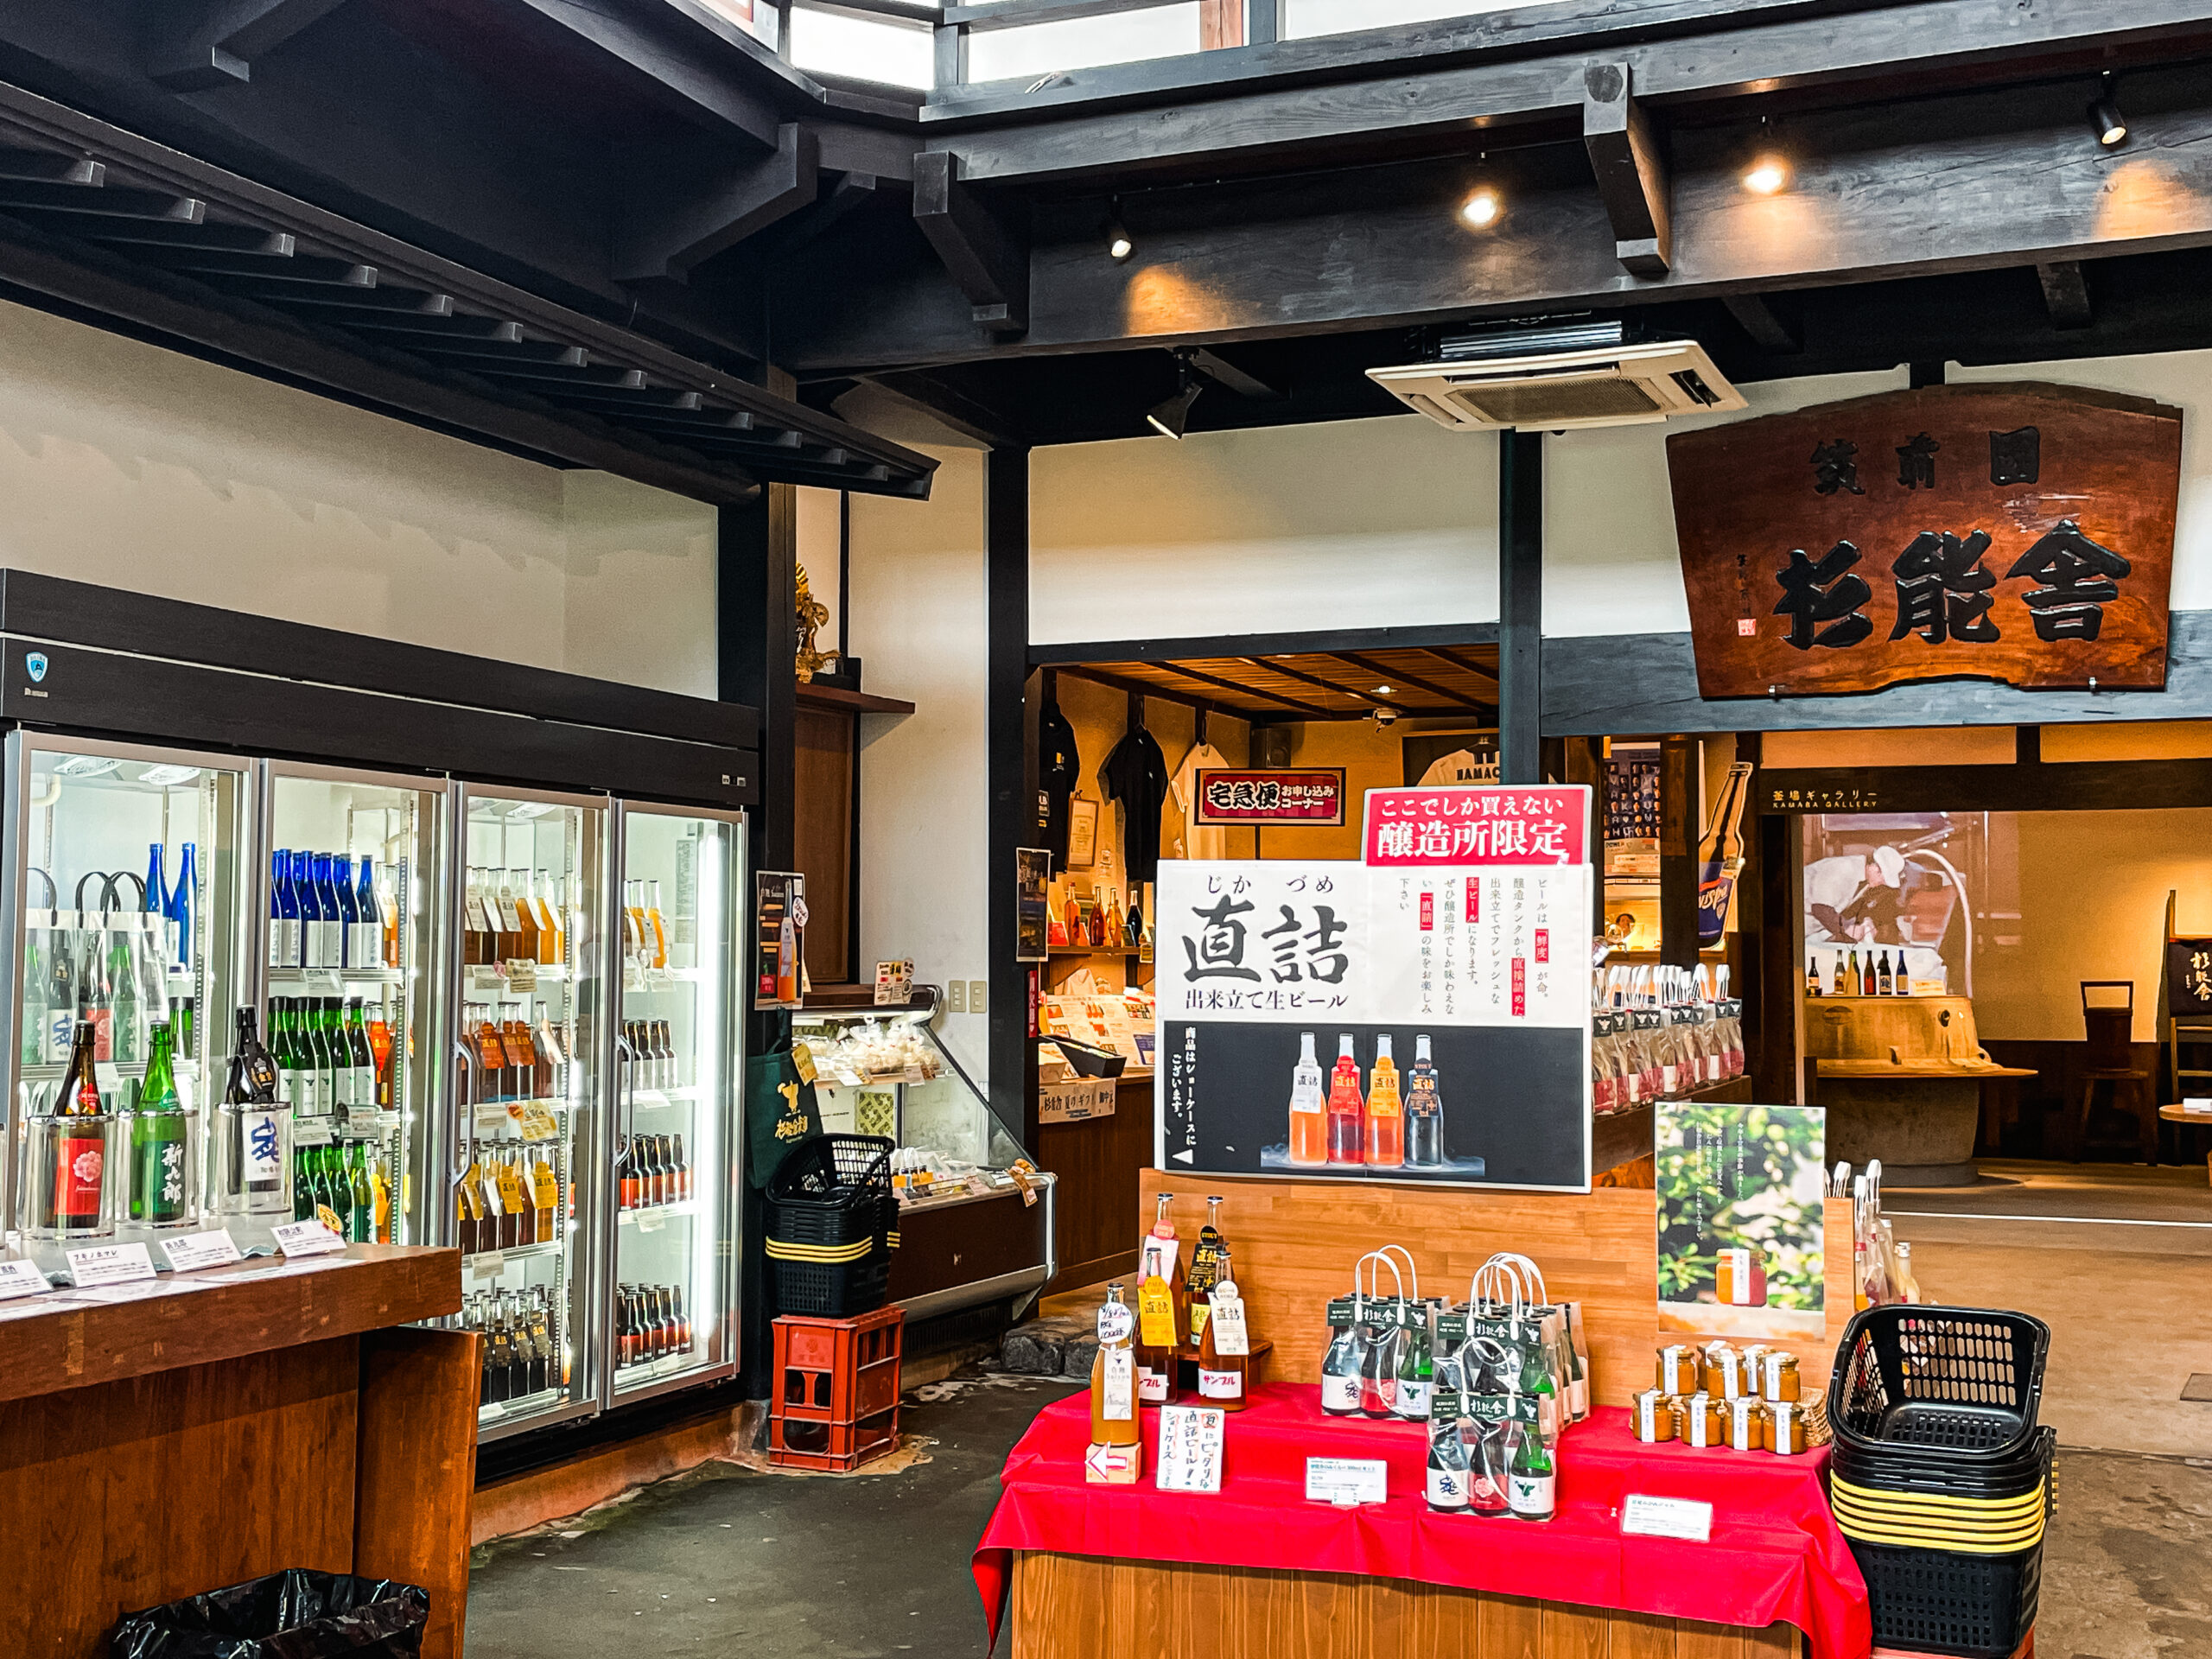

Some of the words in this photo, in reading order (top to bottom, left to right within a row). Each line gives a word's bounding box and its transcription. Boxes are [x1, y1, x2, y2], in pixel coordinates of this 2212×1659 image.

[1207, 780, 1281, 810] 宅急便
[1281, 785, 1334, 798] お申し込み
[1281, 798, 1325, 810] コーナー
[1825, 800, 1878, 809] GALLERY
[1382, 795, 1564, 817] ここでしか買えない
[1376, 818, 1568, 859] 醸造所限定
[1208, 874, 1252, 893] じか
[1286, 874, 1334, 893] づめ
[1399, 878, 1411, 911] 下さい
[1181, 893, 1349, 984] 直詰
[1466, 877, 1479, 985] 生ビールになります。
[1490, 878, 1502, 1004] 出来立てでフレッシュな
[1444, 878, 1456, 1015] ぜひ醸造所でしか味わえな
[1185, 988, 1350, 1011] 出来立て生ビール
[1171, 1053, 1183, 1119] ございます。
[1203, 1375, 1236, 1386] サンプル
